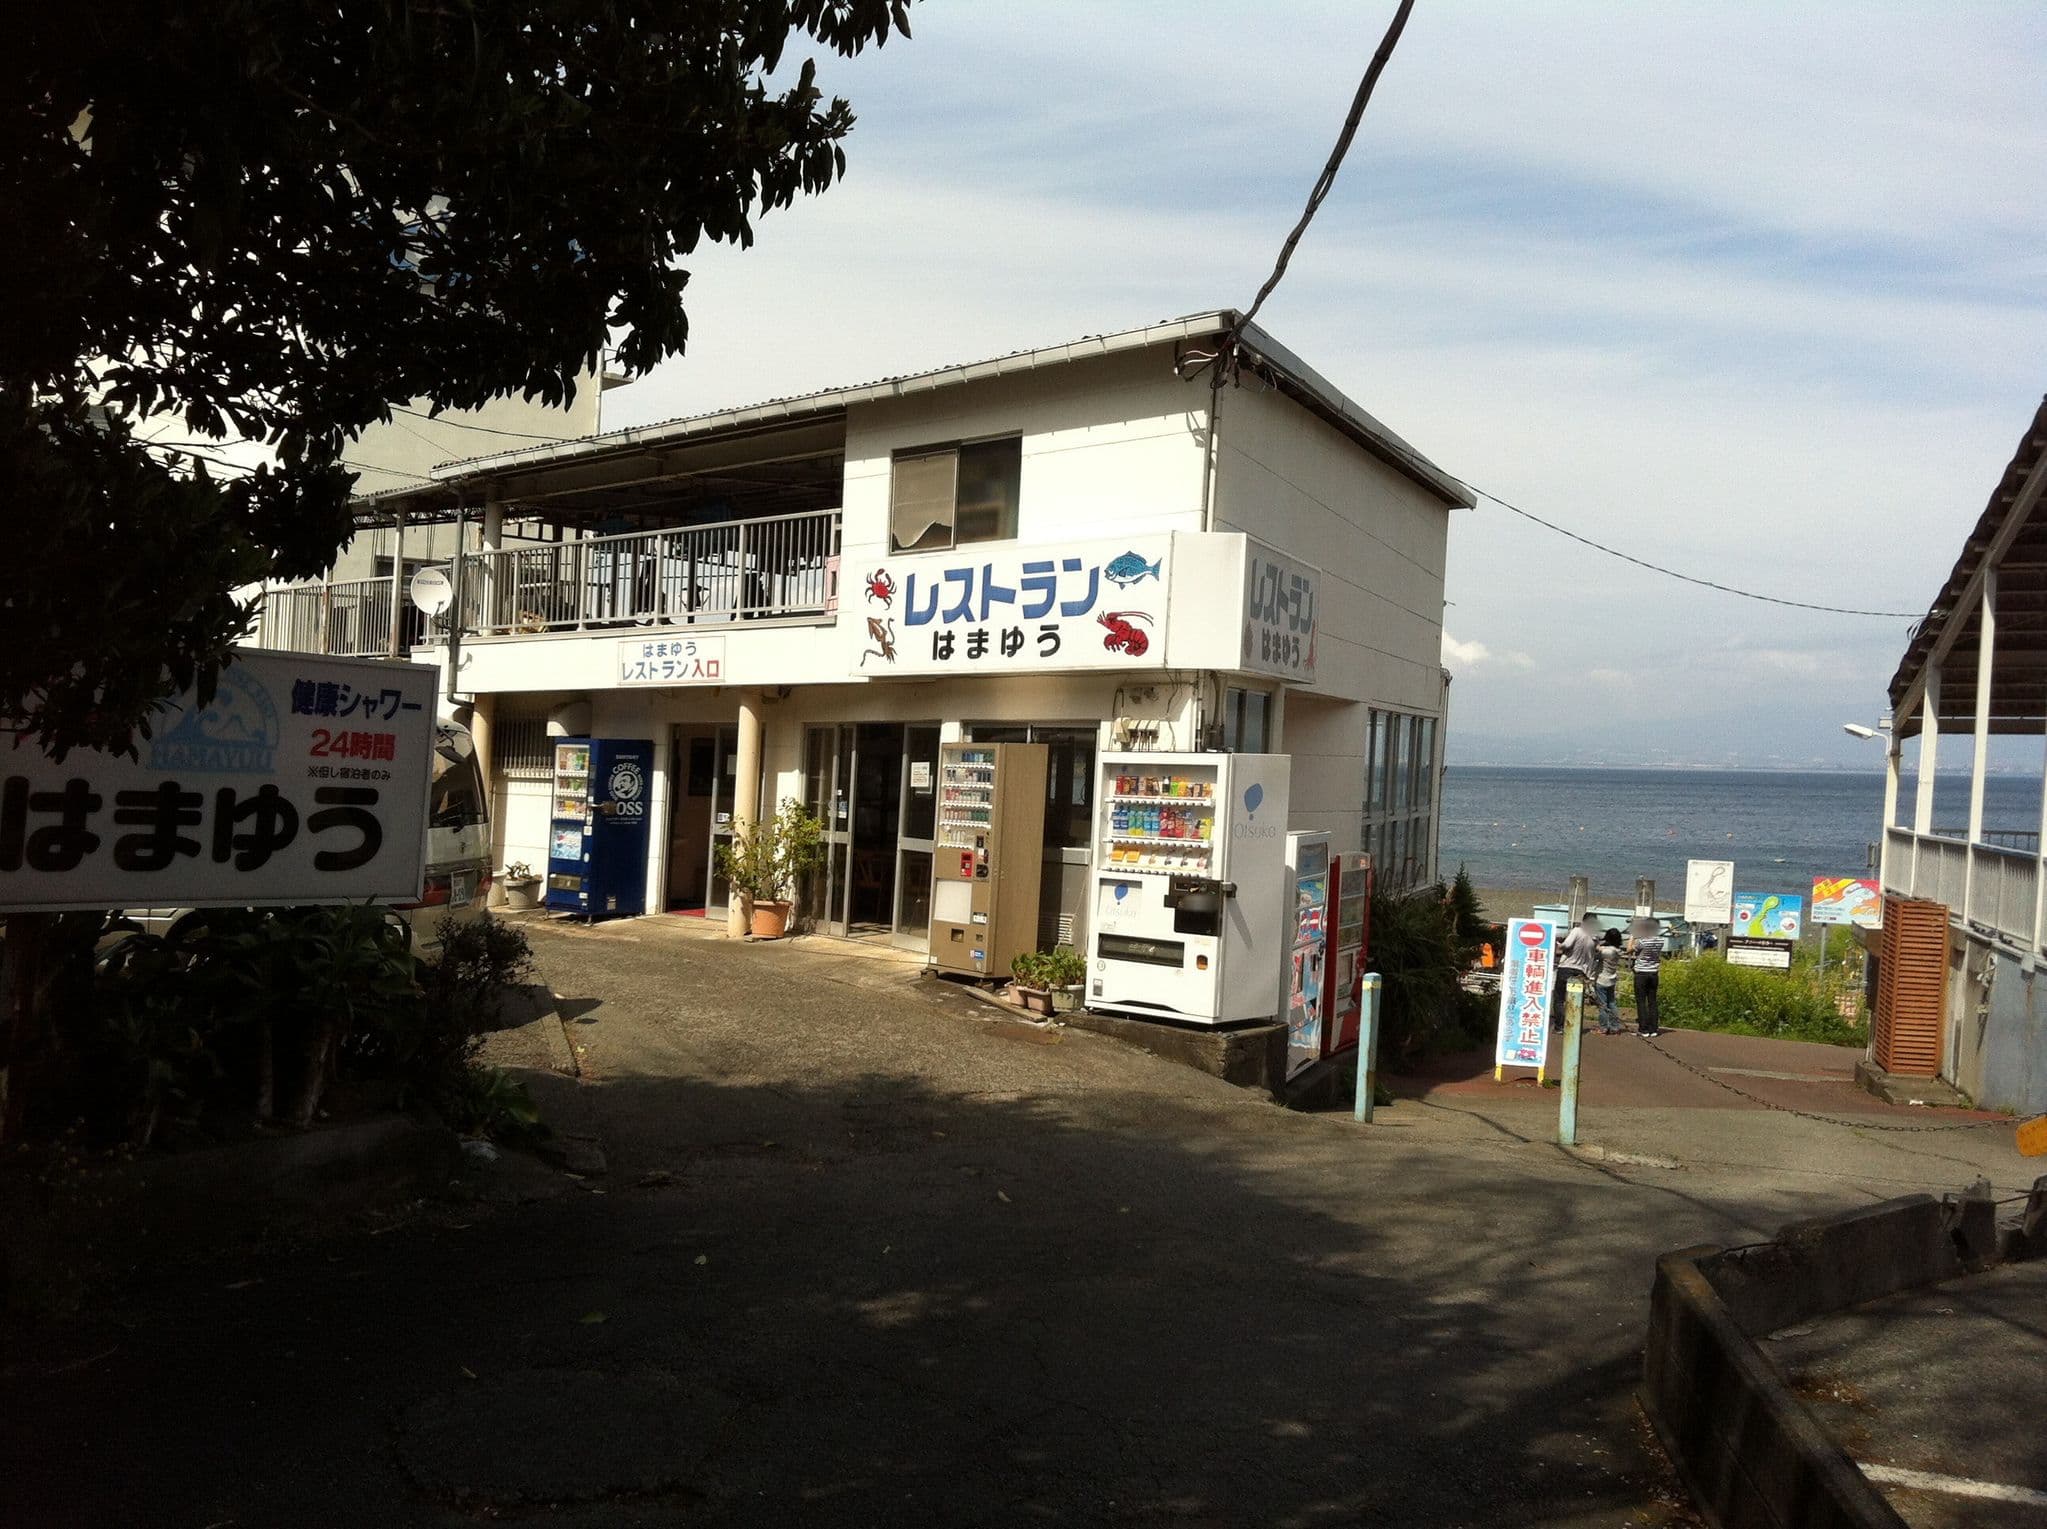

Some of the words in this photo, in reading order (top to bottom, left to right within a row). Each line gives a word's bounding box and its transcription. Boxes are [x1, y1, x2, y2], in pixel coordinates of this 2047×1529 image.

[905, 557, 1100, 627] レストラン
[1249, 557, 1316, 632] レストラン
[642, 640, 697, 658] はまゆう
[932, 624, 1062, 661] はまゆう
[1261, 627, 1301, 669] はまゆう
[621, 657, 720, 681] レストラン入口
[291, 678, 423, 721] 健康シャワー
[310, 728, 396, 761] 24時間
[612, 762, 641, 775] COFFEE
[1, 775, 383, 872] はまゆう
[1234, 822, 1277, 841] Otsuka
